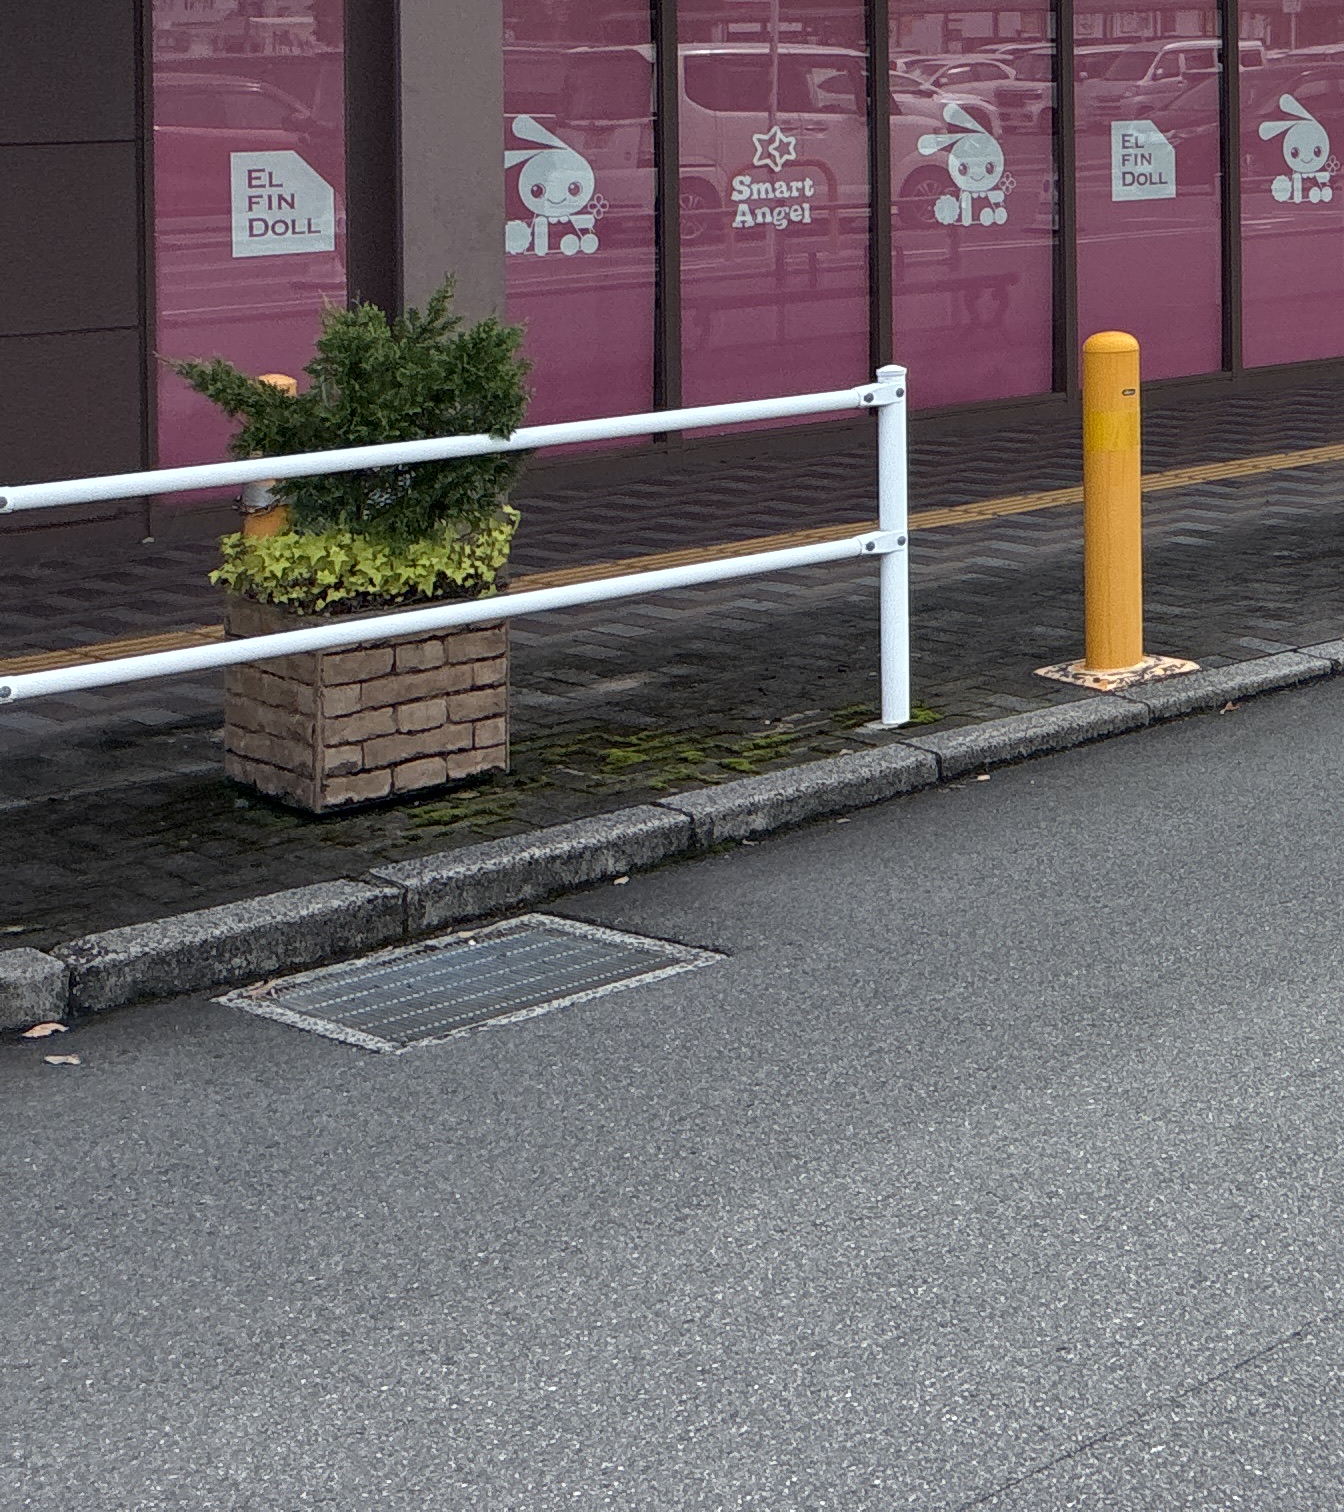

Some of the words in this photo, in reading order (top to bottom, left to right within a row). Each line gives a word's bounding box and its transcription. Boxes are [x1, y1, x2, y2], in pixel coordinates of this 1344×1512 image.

[1120, 152, 1153, 168] FIN
[731, 174, 814, 205] Smart
[246, 193, 297, 213] FIN
[732, 202, 812, 230] Angel
